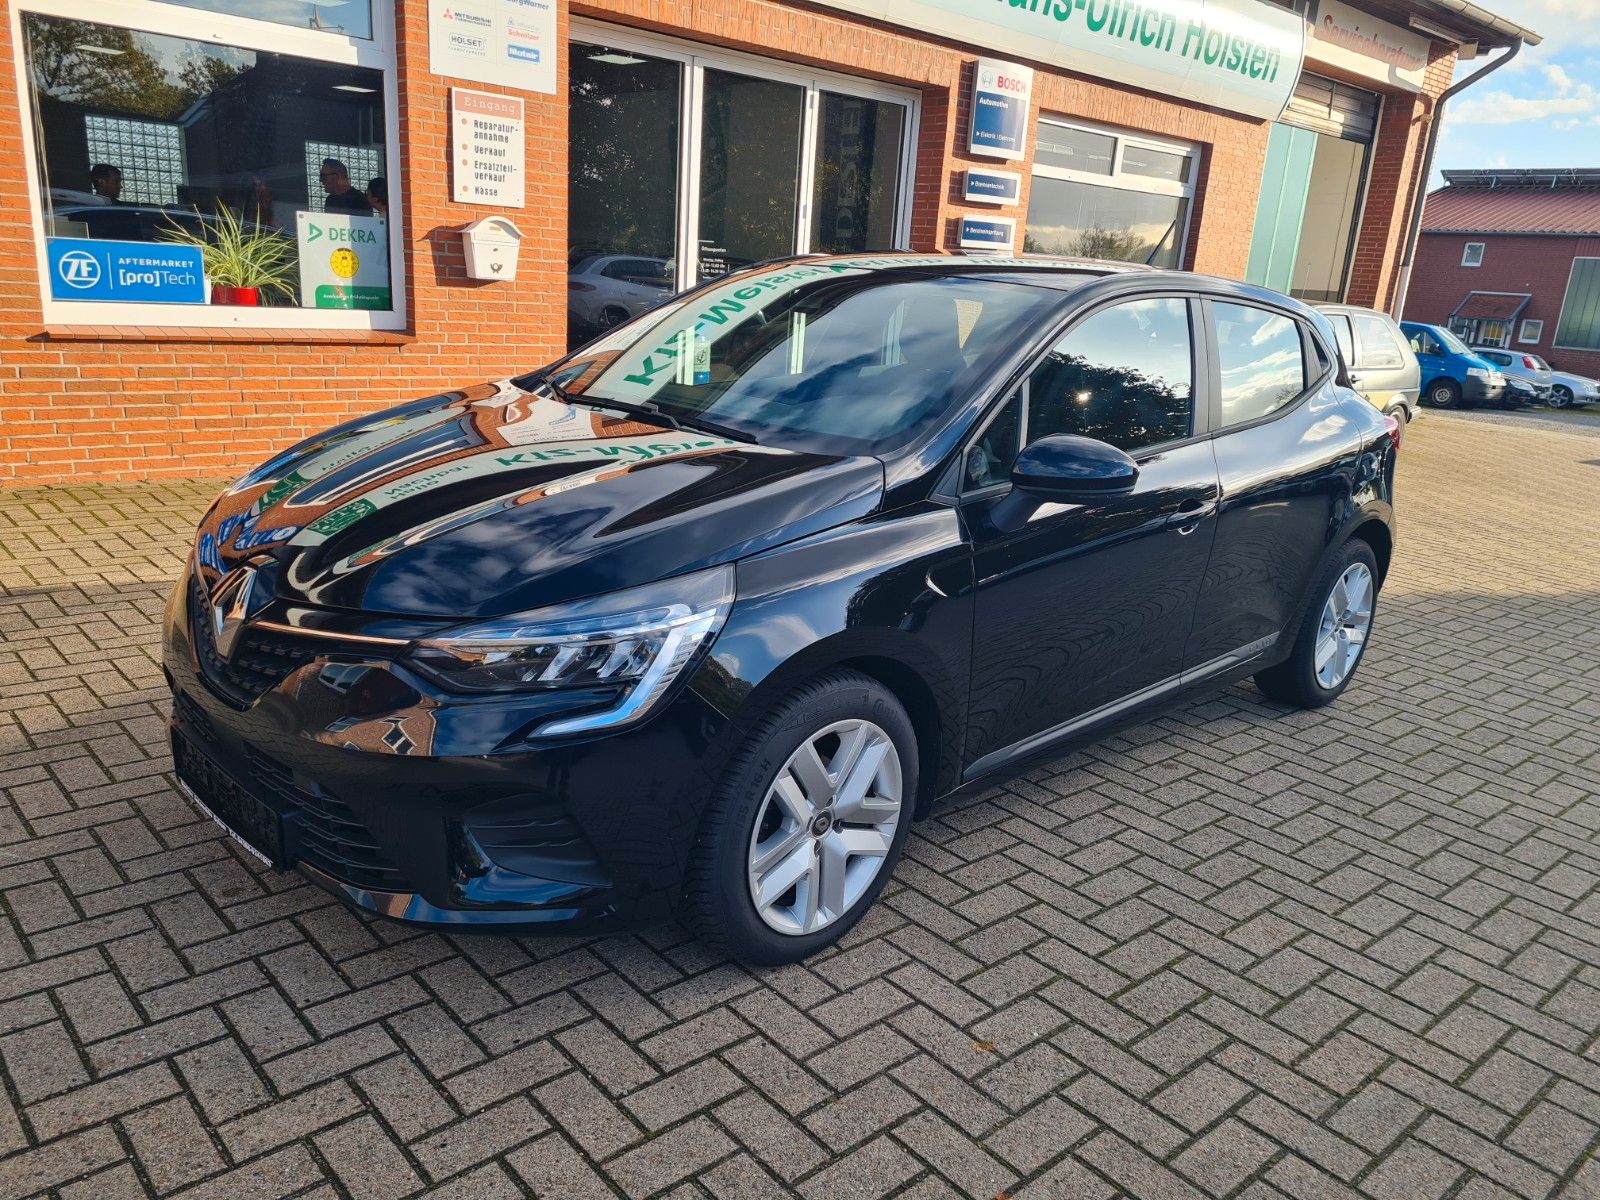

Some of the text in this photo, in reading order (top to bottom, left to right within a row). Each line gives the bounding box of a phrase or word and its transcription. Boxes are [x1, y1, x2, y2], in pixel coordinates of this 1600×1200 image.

[506, 0, 549, 10] orgWarner
[451, 35, 482, 47] HOLSET
[1008, 0, 1280, 84] s-Ulrich Holsten
[997, 75, 1026, 92] BOSCH
[463, 96, 515, 114] Eingang
[474, 119, 518, 133] Reparatur-
[474, 131, 509, 143] annahme
[474, 145, 506, 157] Verkauf
[474, 160, 517, 173] Ersatzteil-
[474, 172, 506, 183] verkauf
[475, 186, 498, 196] Kasse
[328, 227, 377, 244] DEKRA
[118, 257, 194, 268] AFTERMARKET
